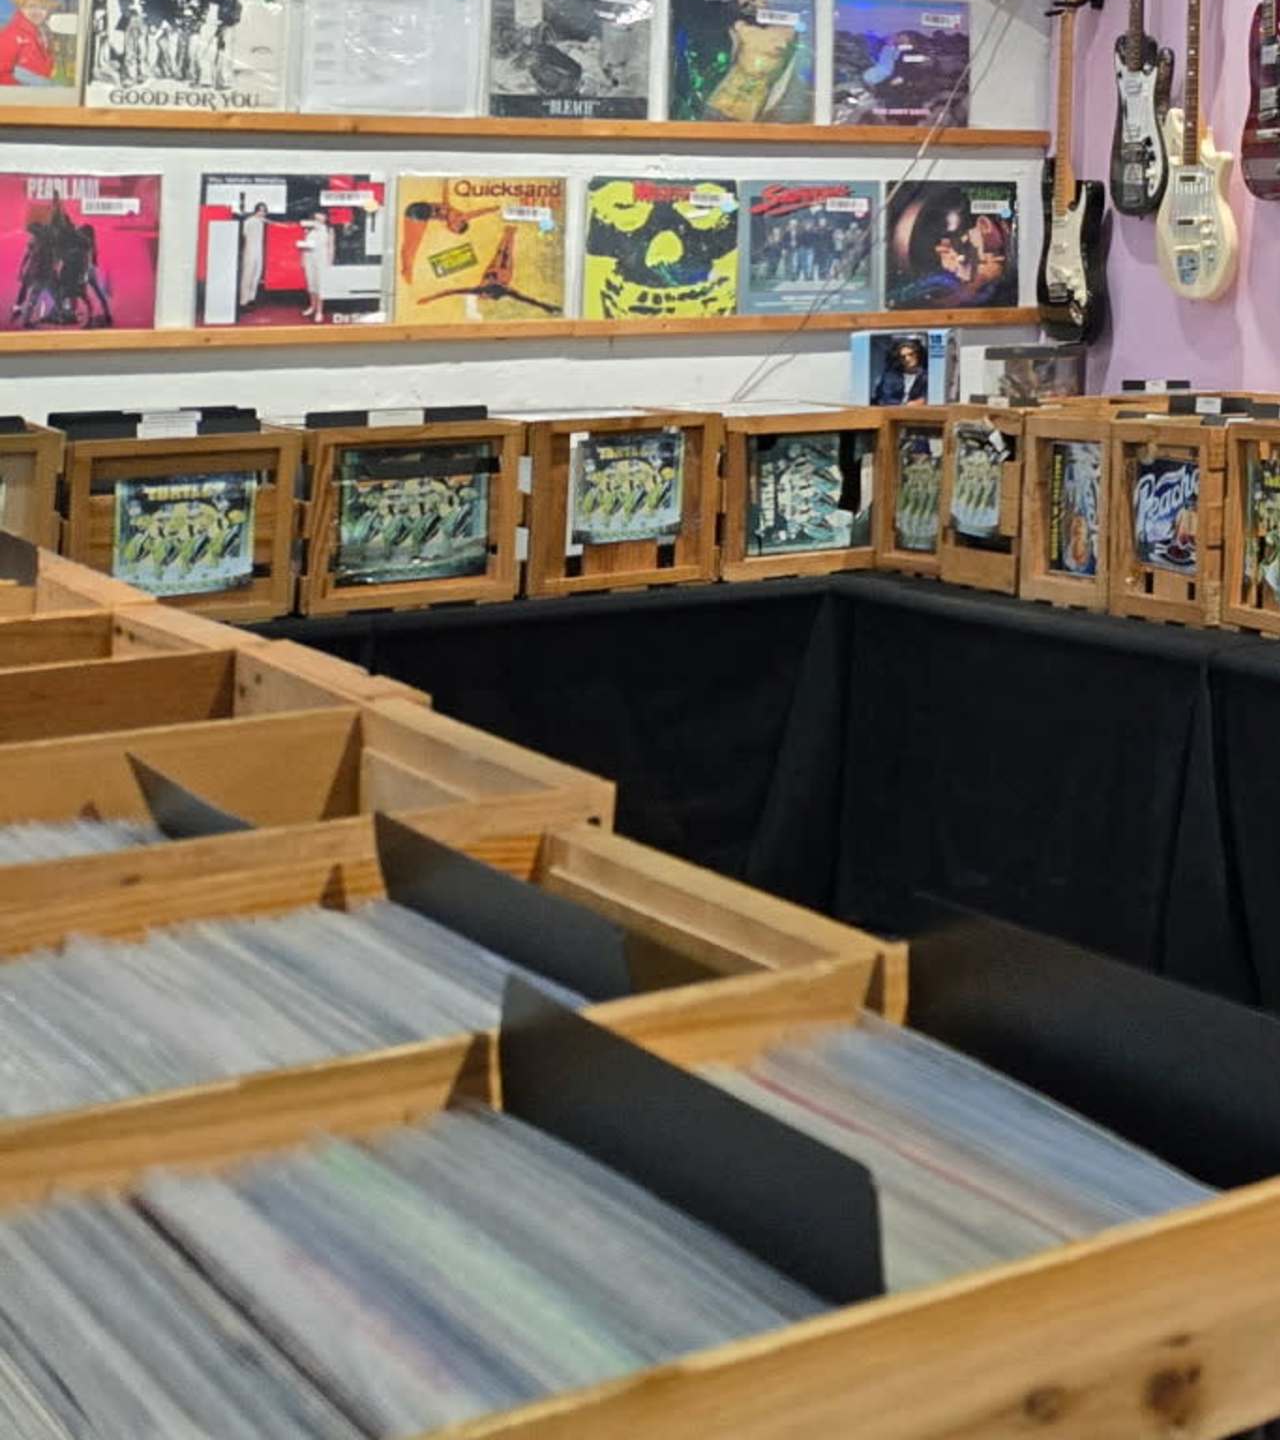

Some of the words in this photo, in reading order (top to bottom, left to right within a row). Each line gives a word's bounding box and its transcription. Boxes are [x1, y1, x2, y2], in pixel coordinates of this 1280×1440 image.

[109, 89, 169, 106] GOOD
[174, 92, 217, 111] FOR
[216, 93, 260, 108] YOU
[454, 180, 561, 198] Quicksand
